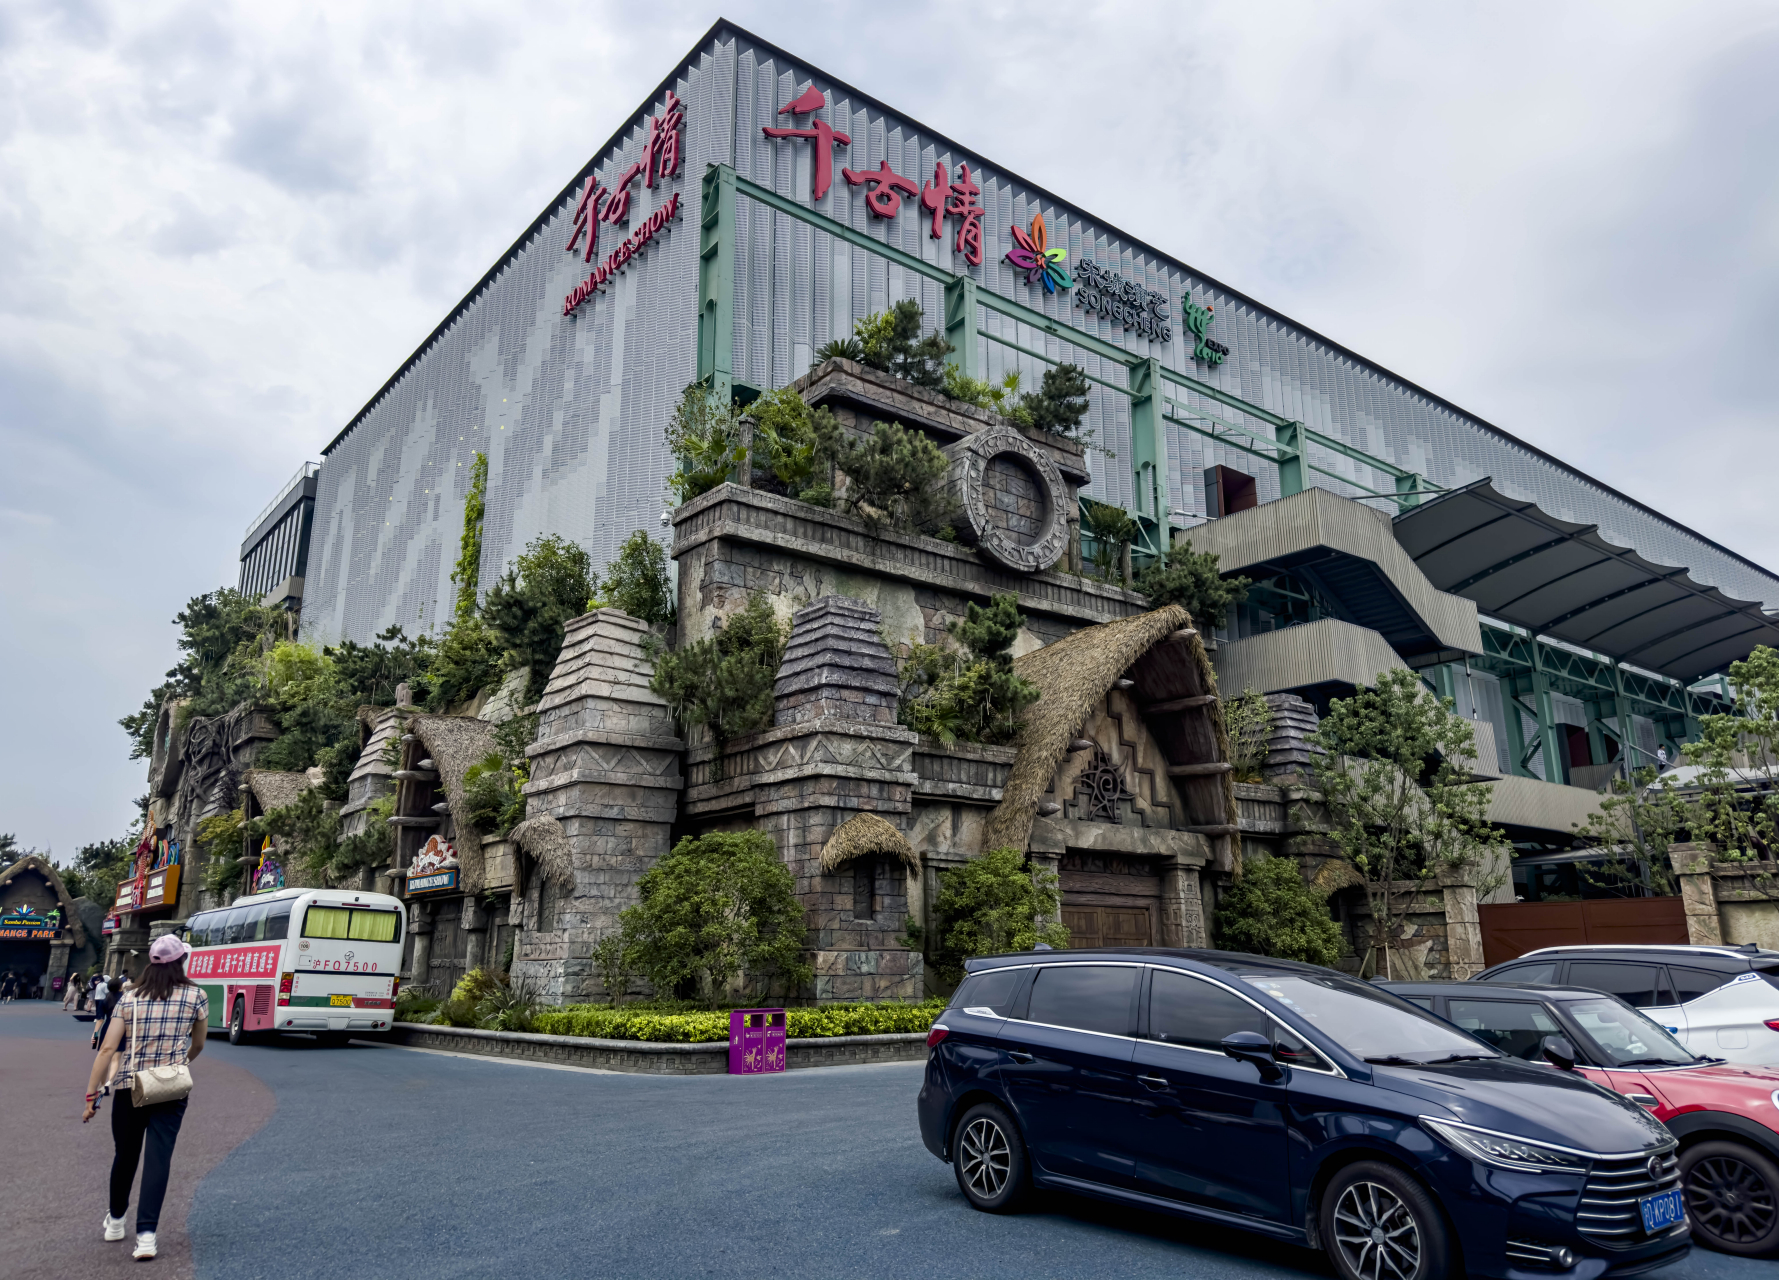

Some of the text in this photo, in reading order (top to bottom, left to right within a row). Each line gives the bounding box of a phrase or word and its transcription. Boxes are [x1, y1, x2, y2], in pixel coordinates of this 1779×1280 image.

[1078, 258, 1170, 321] 宋城演艺
[1078, 286, 1172, 342] SONGCHENG
[1205, 338, 1230, 356] EXPO
[31, 930, 55, 938] PARK
